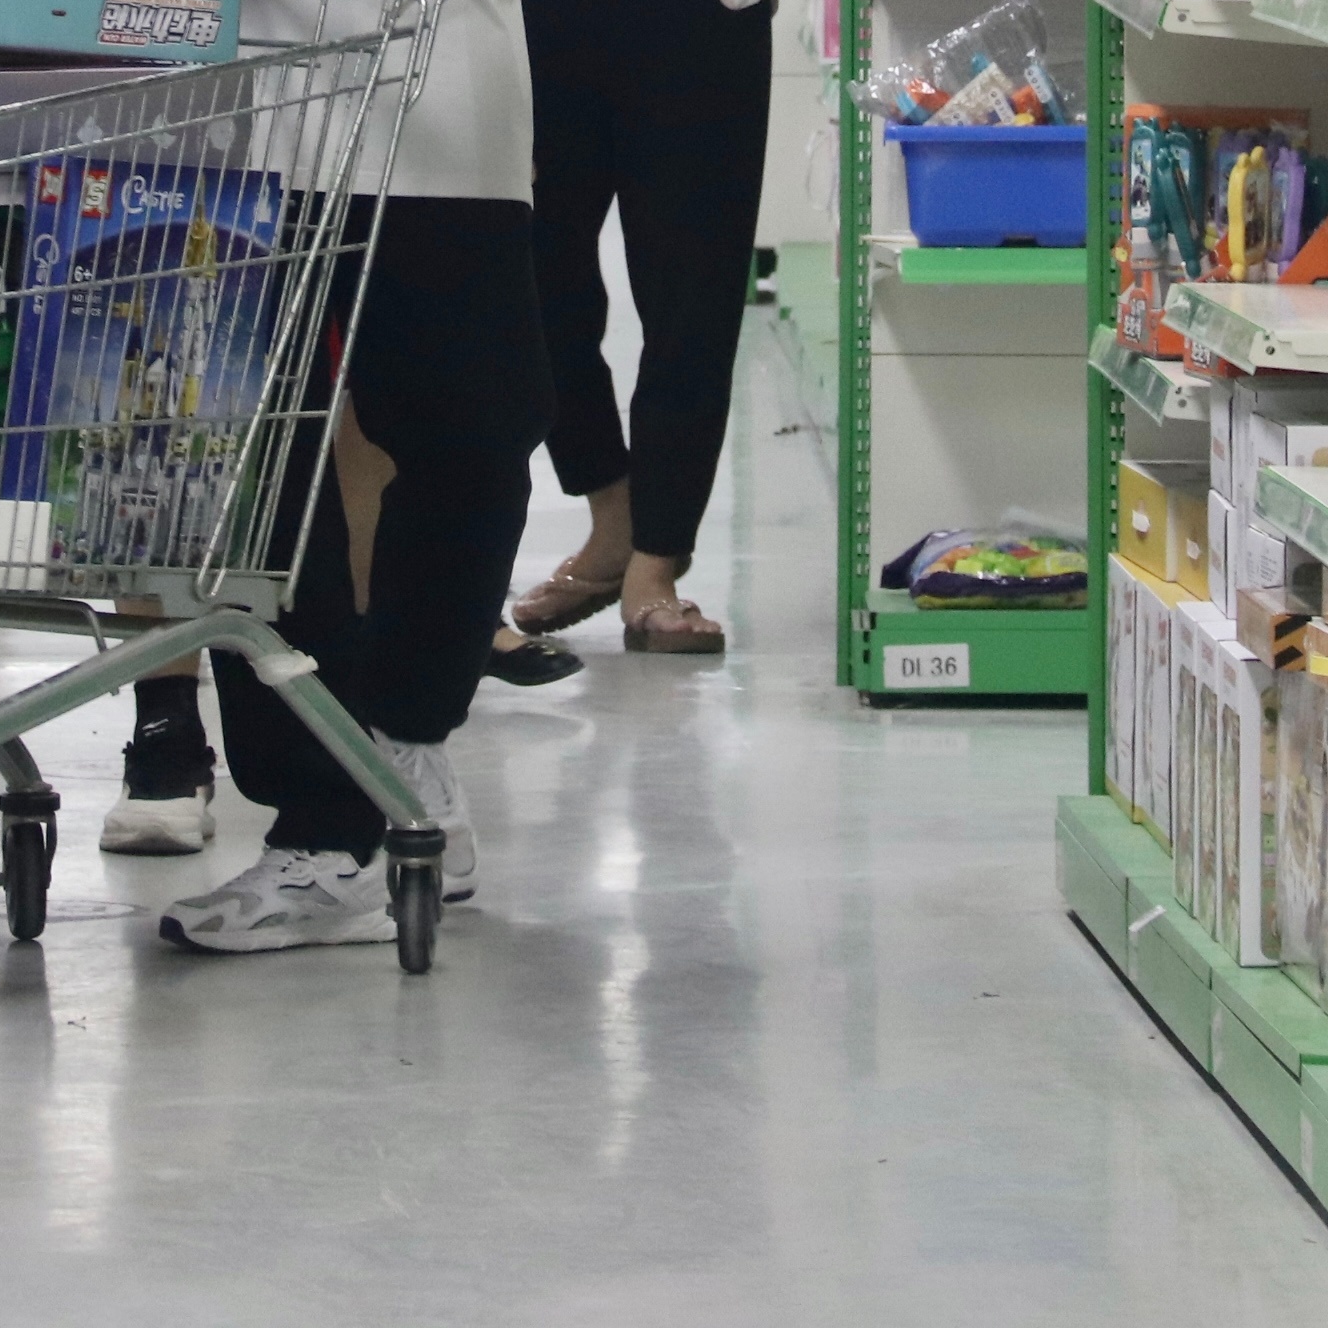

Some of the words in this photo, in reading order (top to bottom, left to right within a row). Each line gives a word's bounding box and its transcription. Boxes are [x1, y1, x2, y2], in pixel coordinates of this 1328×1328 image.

[102, 4, 222, 49] 电动水枪
[930, 657, 958, 676] 36
